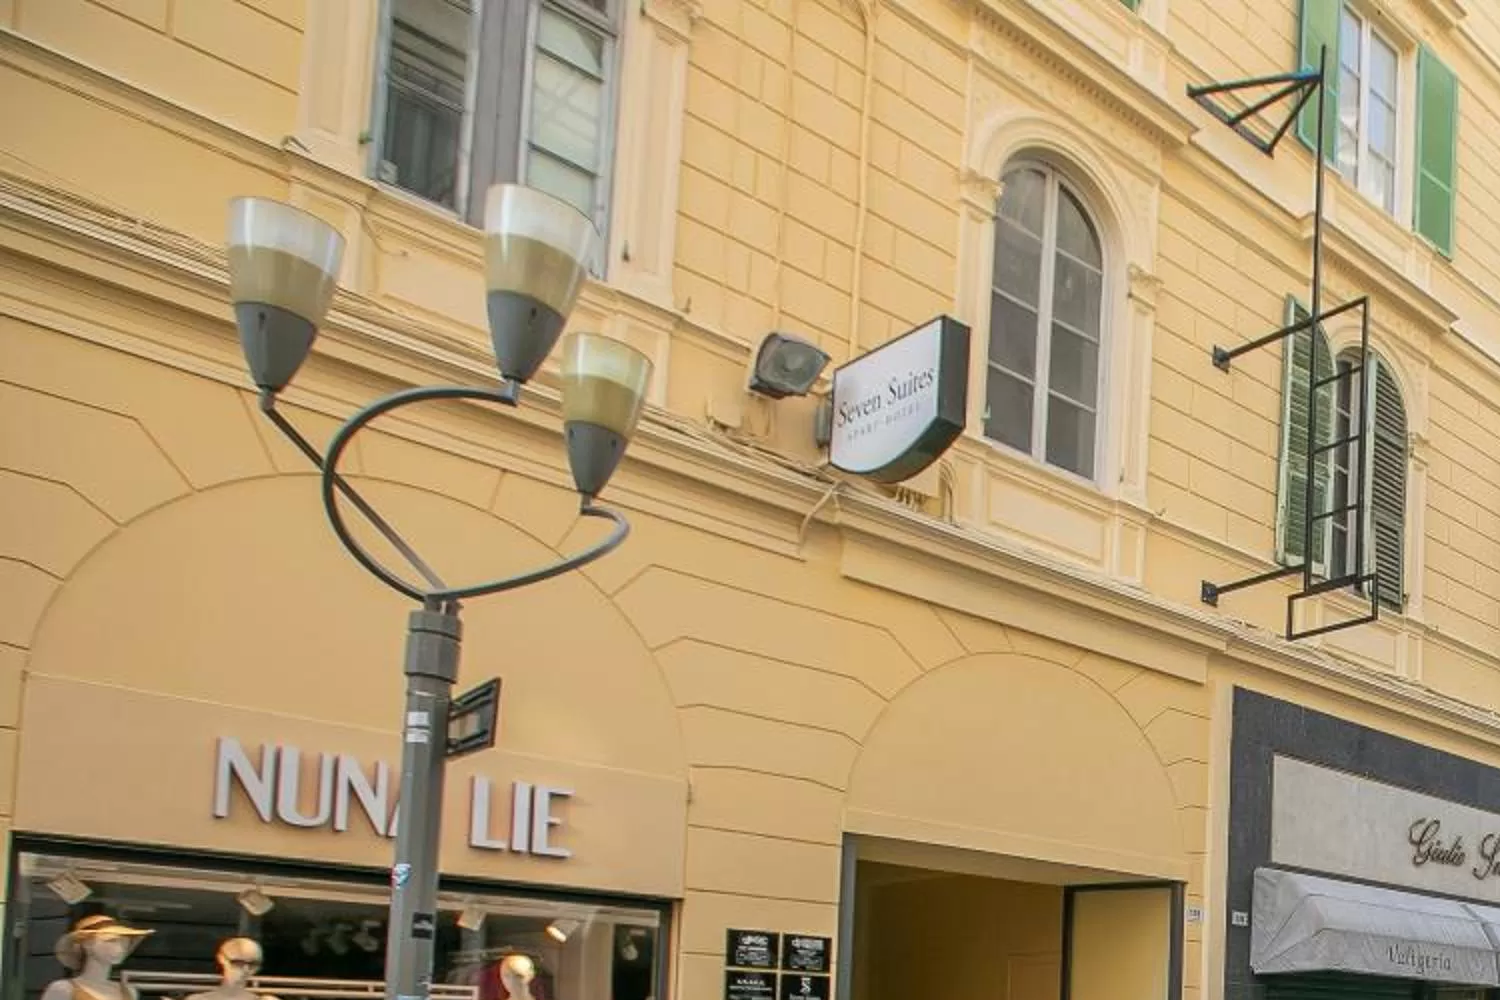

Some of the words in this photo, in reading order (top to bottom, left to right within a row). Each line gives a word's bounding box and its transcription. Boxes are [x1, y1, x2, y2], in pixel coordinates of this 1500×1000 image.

[838, 394, 881, 428] Seven
[888, 367, 934, 405] Suites
[213, 736, 400, 838] NUN
[469, 774, 575, 857] LIE
[1408, 817, 1466, 867] Giulio
